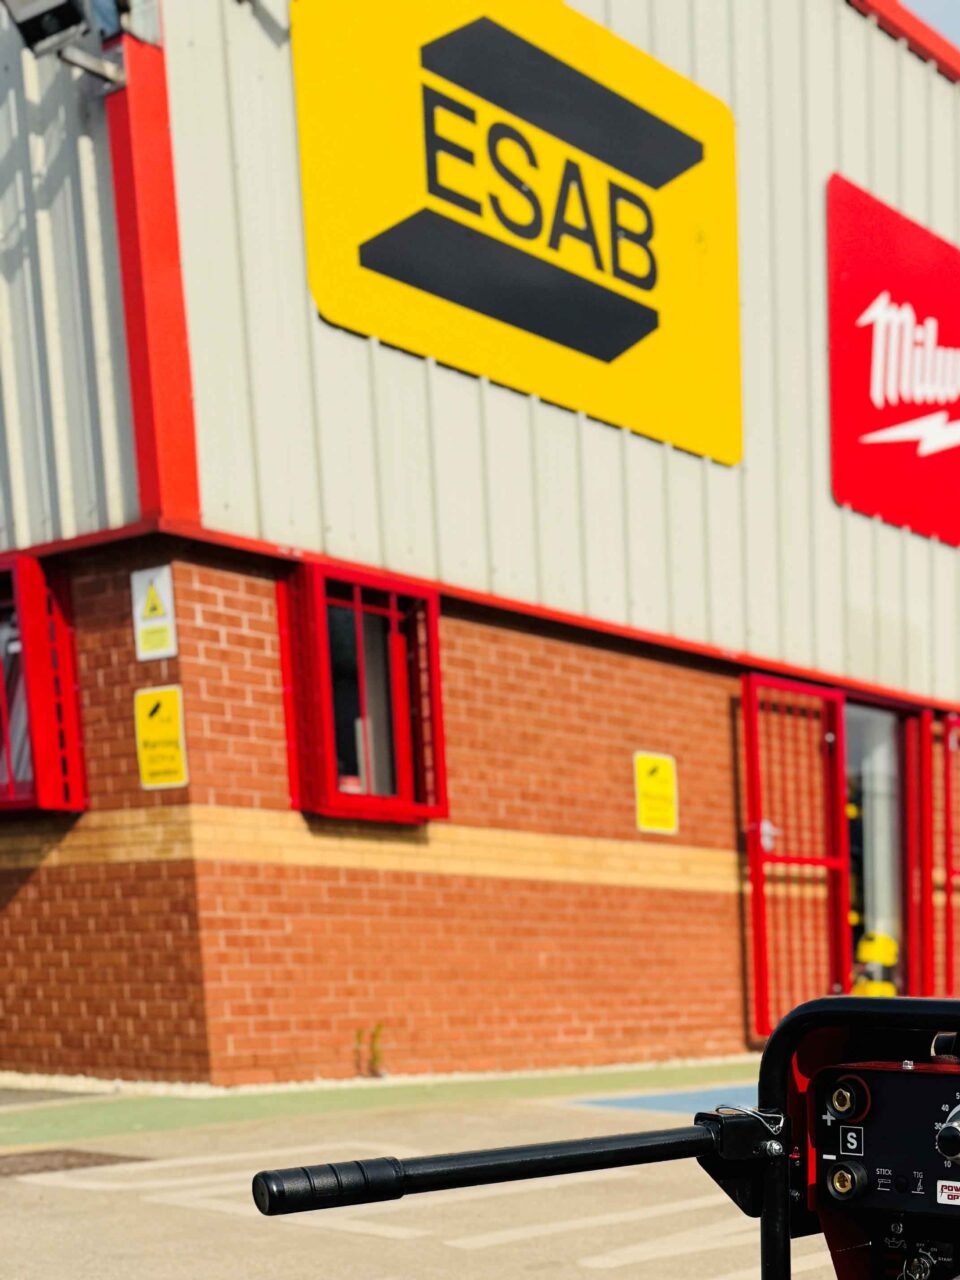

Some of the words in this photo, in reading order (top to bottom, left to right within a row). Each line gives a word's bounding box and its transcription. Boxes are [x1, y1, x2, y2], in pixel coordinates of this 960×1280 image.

[422, 83, 658, 292] ESAB
[941, 1104, 949, 1112] 40
[846, 1132, 857, 1149] S
[943, 1160, 952, 1168] 10
[875, 1168, 892, 1176] STICK
[913, 1171, 924, 1179] TIG
